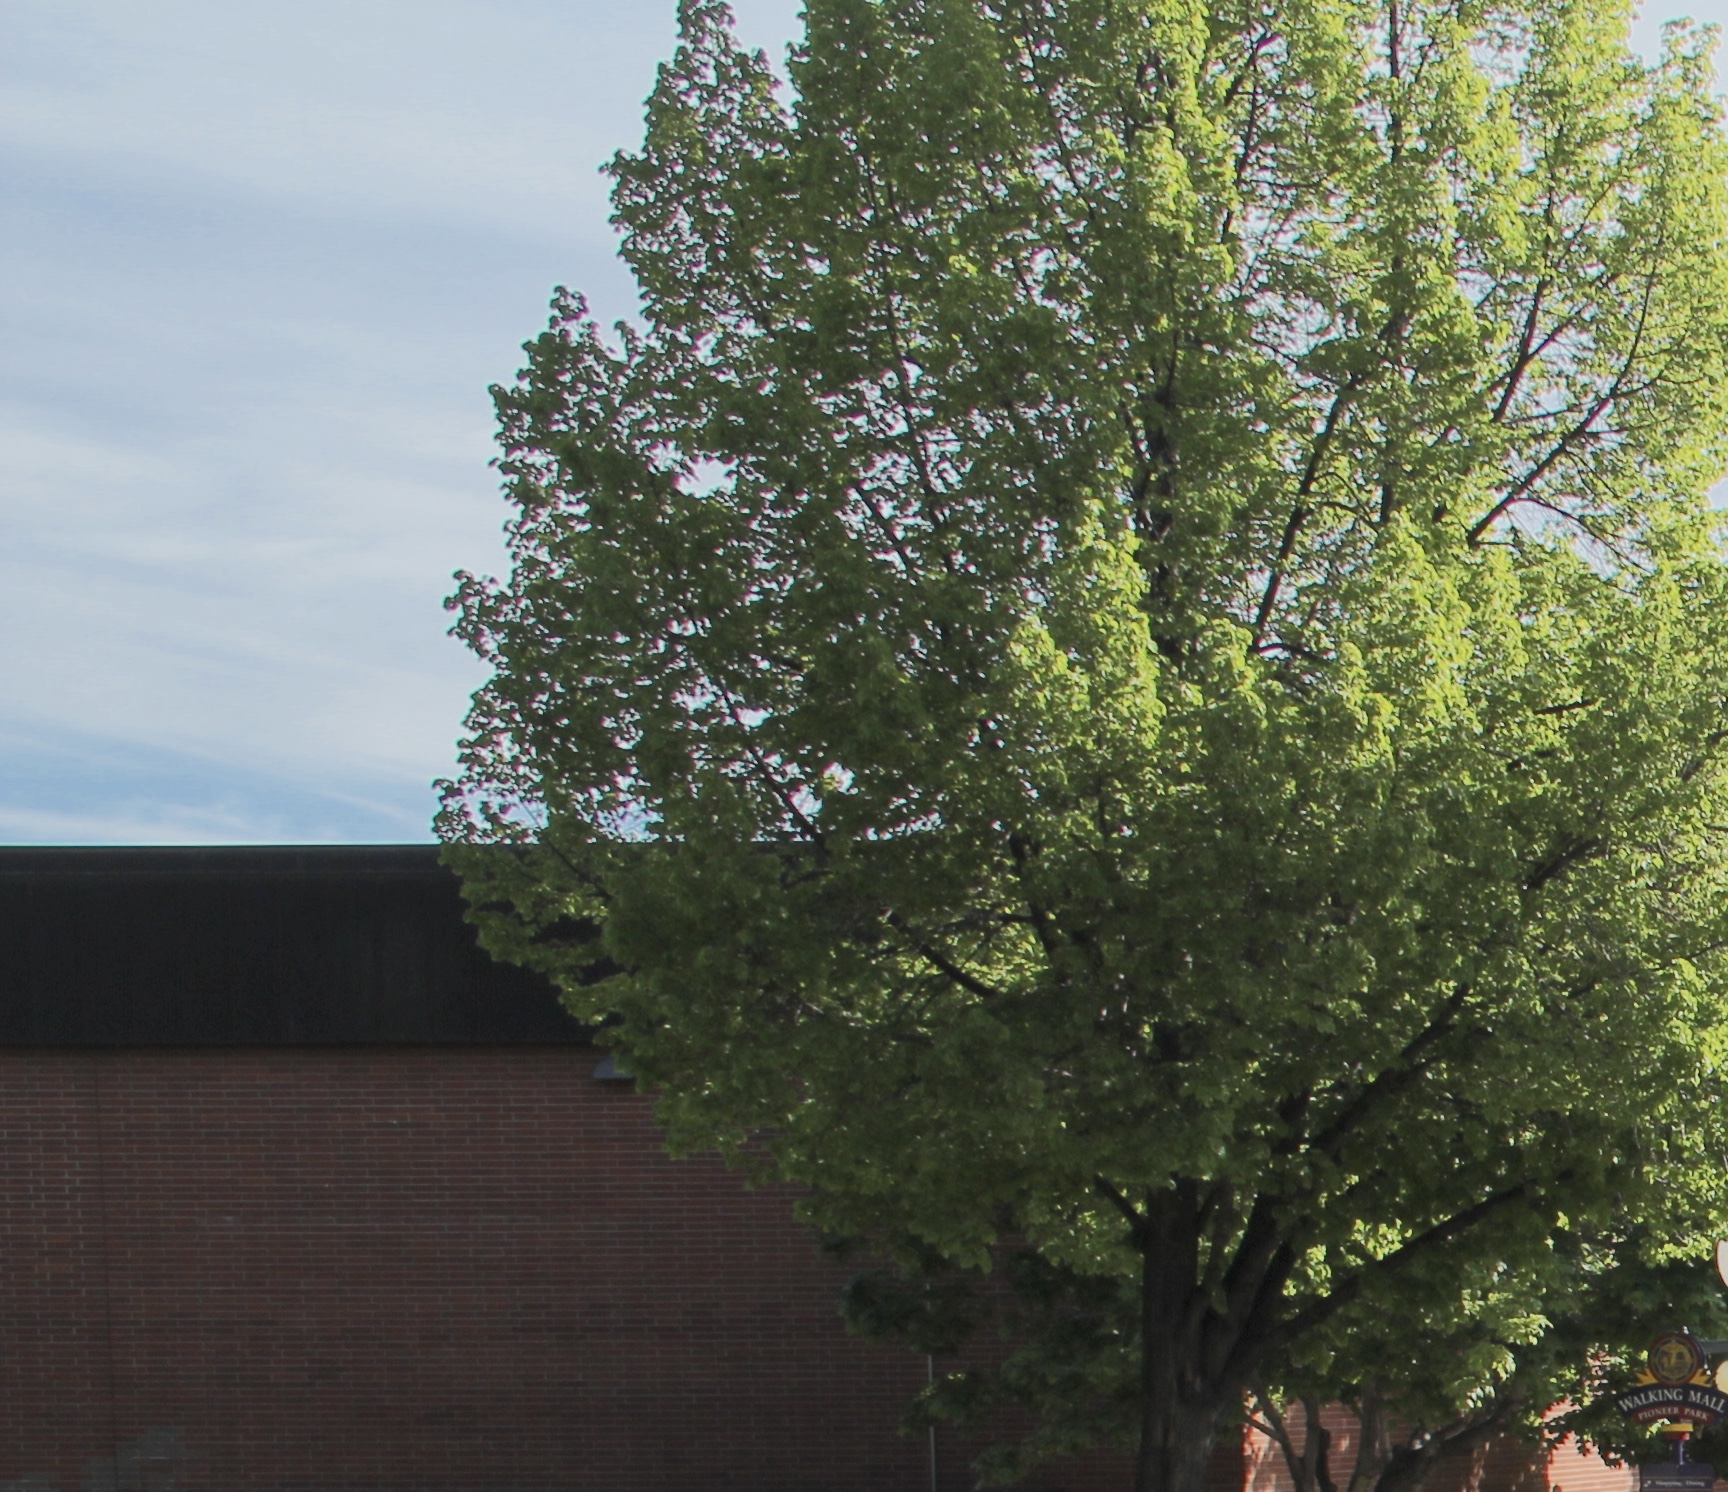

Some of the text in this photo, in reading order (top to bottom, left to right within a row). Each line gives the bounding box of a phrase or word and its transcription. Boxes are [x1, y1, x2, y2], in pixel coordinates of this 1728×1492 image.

[1619, 1388, 1727, 1413] WALKING MALL
[1638, 1406, 1708, 1420] PIONEER PARK
